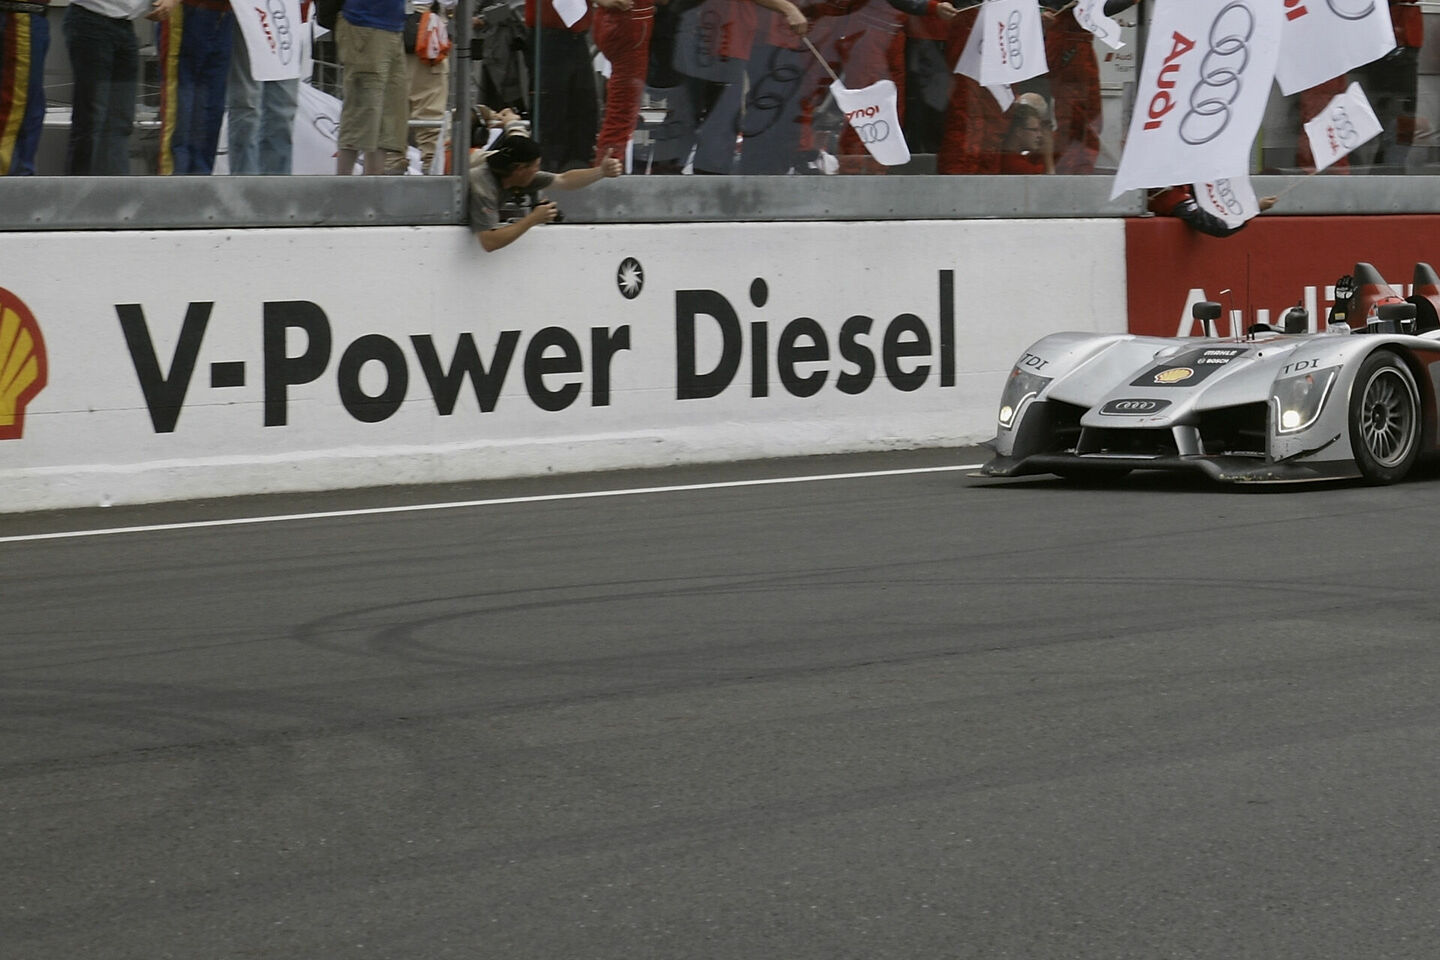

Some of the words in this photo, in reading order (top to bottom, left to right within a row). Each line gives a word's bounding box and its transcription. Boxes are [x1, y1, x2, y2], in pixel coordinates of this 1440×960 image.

[1143, 31, 1196, 131] Audi
[115, 300, 630, 434] V-Power
[675, 269, 957, 402] Diesel
[1020, 353, 1050, 372] TDI
[1283, 358, 1320, 375] TDI
